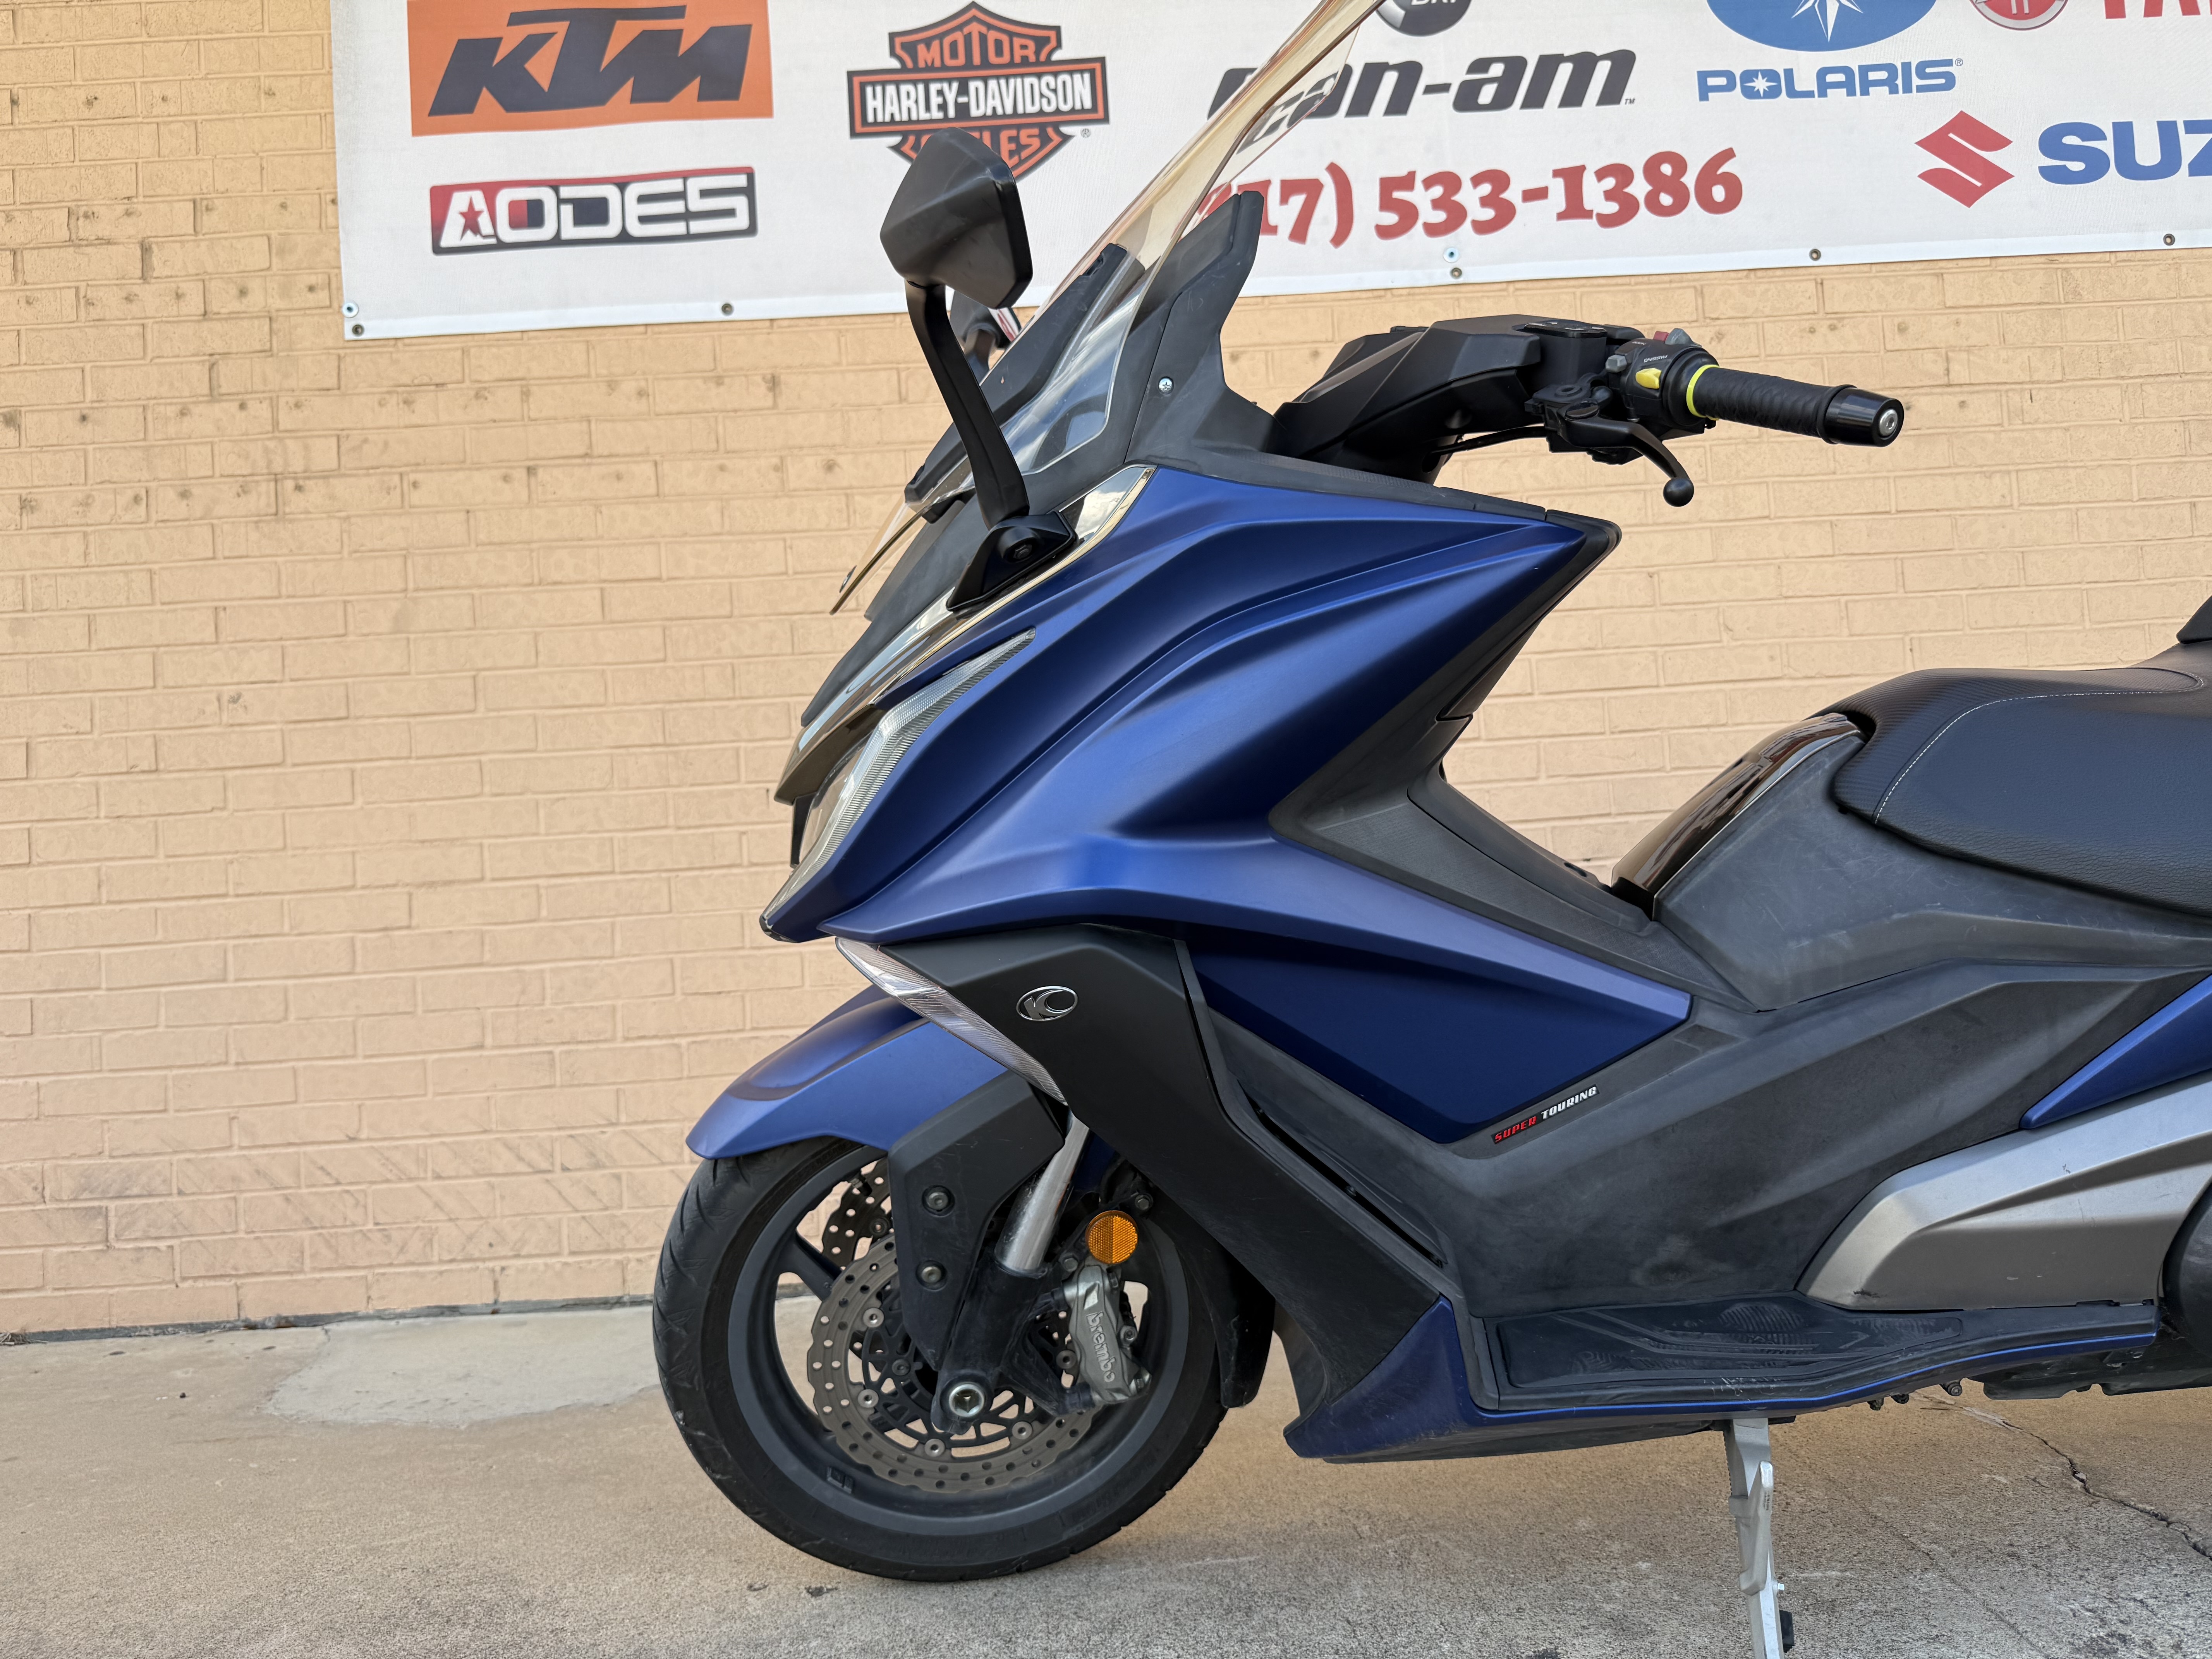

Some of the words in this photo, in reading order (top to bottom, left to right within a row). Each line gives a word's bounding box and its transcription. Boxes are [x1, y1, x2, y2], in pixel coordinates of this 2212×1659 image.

[428, 5, 752, 117] KTM
[917, 22, 1036, 68] MOTOR
[865, 72, 1092, 123] HARLEY-DAVIDSON
[1697, 58, 1956, 102] POLARIS
[440, 173, 750, 248] AODES
[1374, 148, 1743, 240] 533-1386
[1494, 1116, 1537, 1142] SUPER
[1541, 1086, 1596, 1120] TOURING
[1086, 1310, 1116, 1382] brembo
